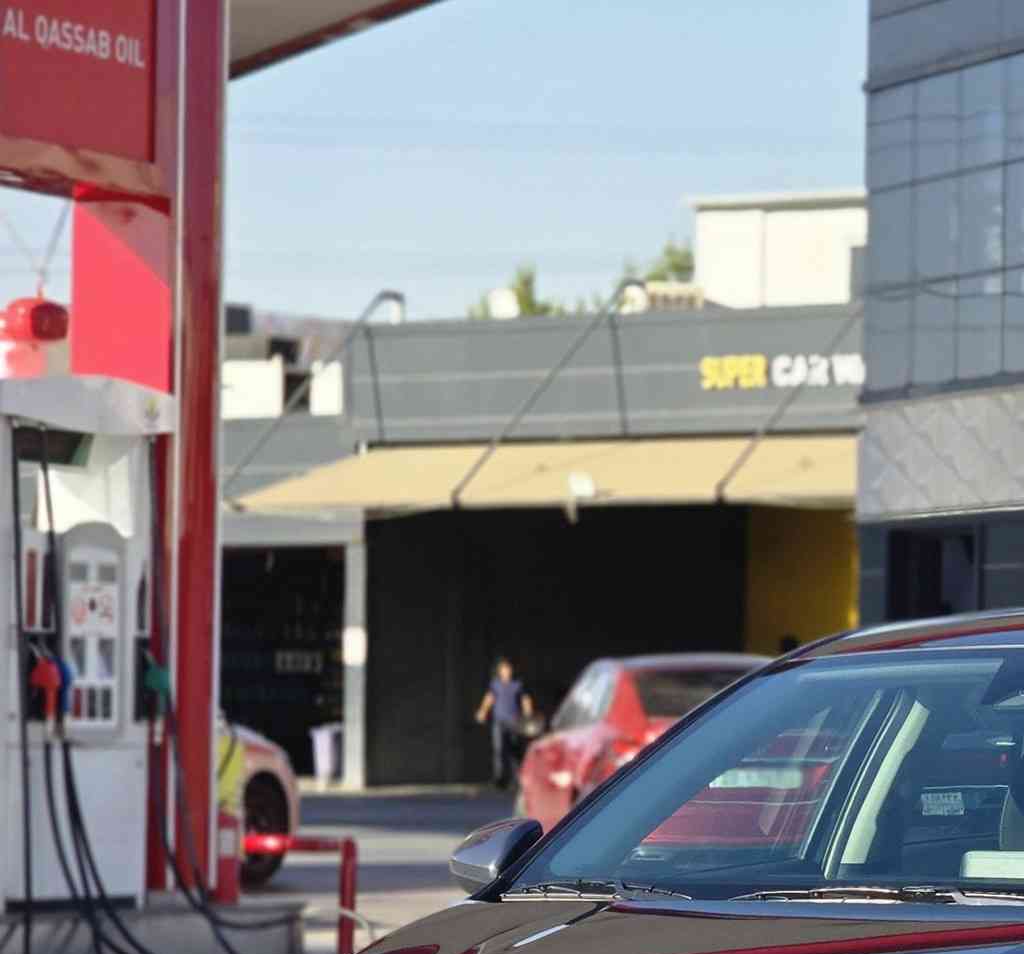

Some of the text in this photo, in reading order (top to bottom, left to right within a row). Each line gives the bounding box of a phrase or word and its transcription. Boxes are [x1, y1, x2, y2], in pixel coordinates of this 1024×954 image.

[3, 8, 145, 68] AL QASSAB OIL
